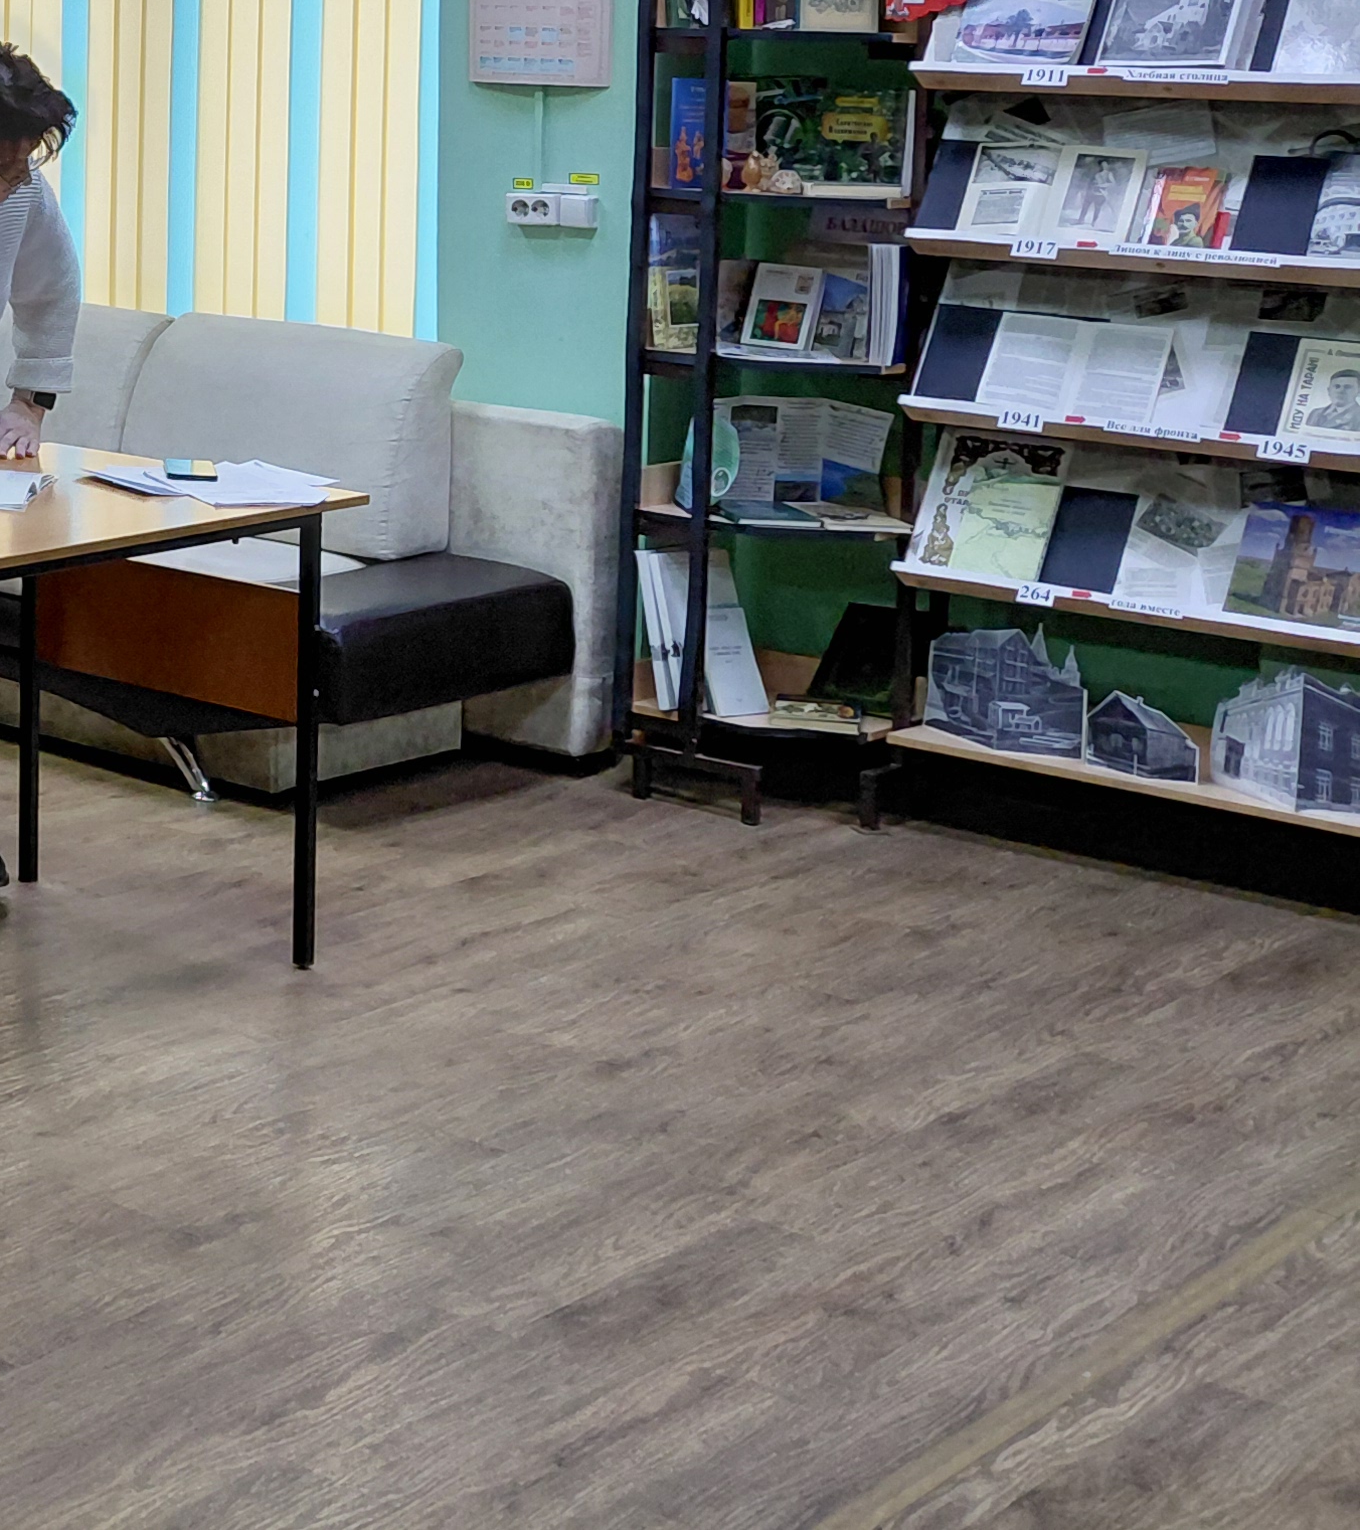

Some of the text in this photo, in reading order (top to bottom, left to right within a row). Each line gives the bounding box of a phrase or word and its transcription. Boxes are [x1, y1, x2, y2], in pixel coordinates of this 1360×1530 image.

[1026, 68, 1066, 83] 1911
[1126, 69, 1229, 82] Хлебная столица
[1015, 239, 1057, 255] 1917
[1114, 244, 1151, 255] Лицом
[1164, 250, 1192, 260] лицу
[1204, 253, 1277, 266] революцией
[1296, 393, 1310, 406] НА
[1001, 410, 1041, 428] 1941
[1106, 420, 1198, 440] Все для фронта
[1262, 440, 1308, 459] 1945
[1019, 585, 1052, 602] 264
[1111, 599, 1181, 617] года вместе
